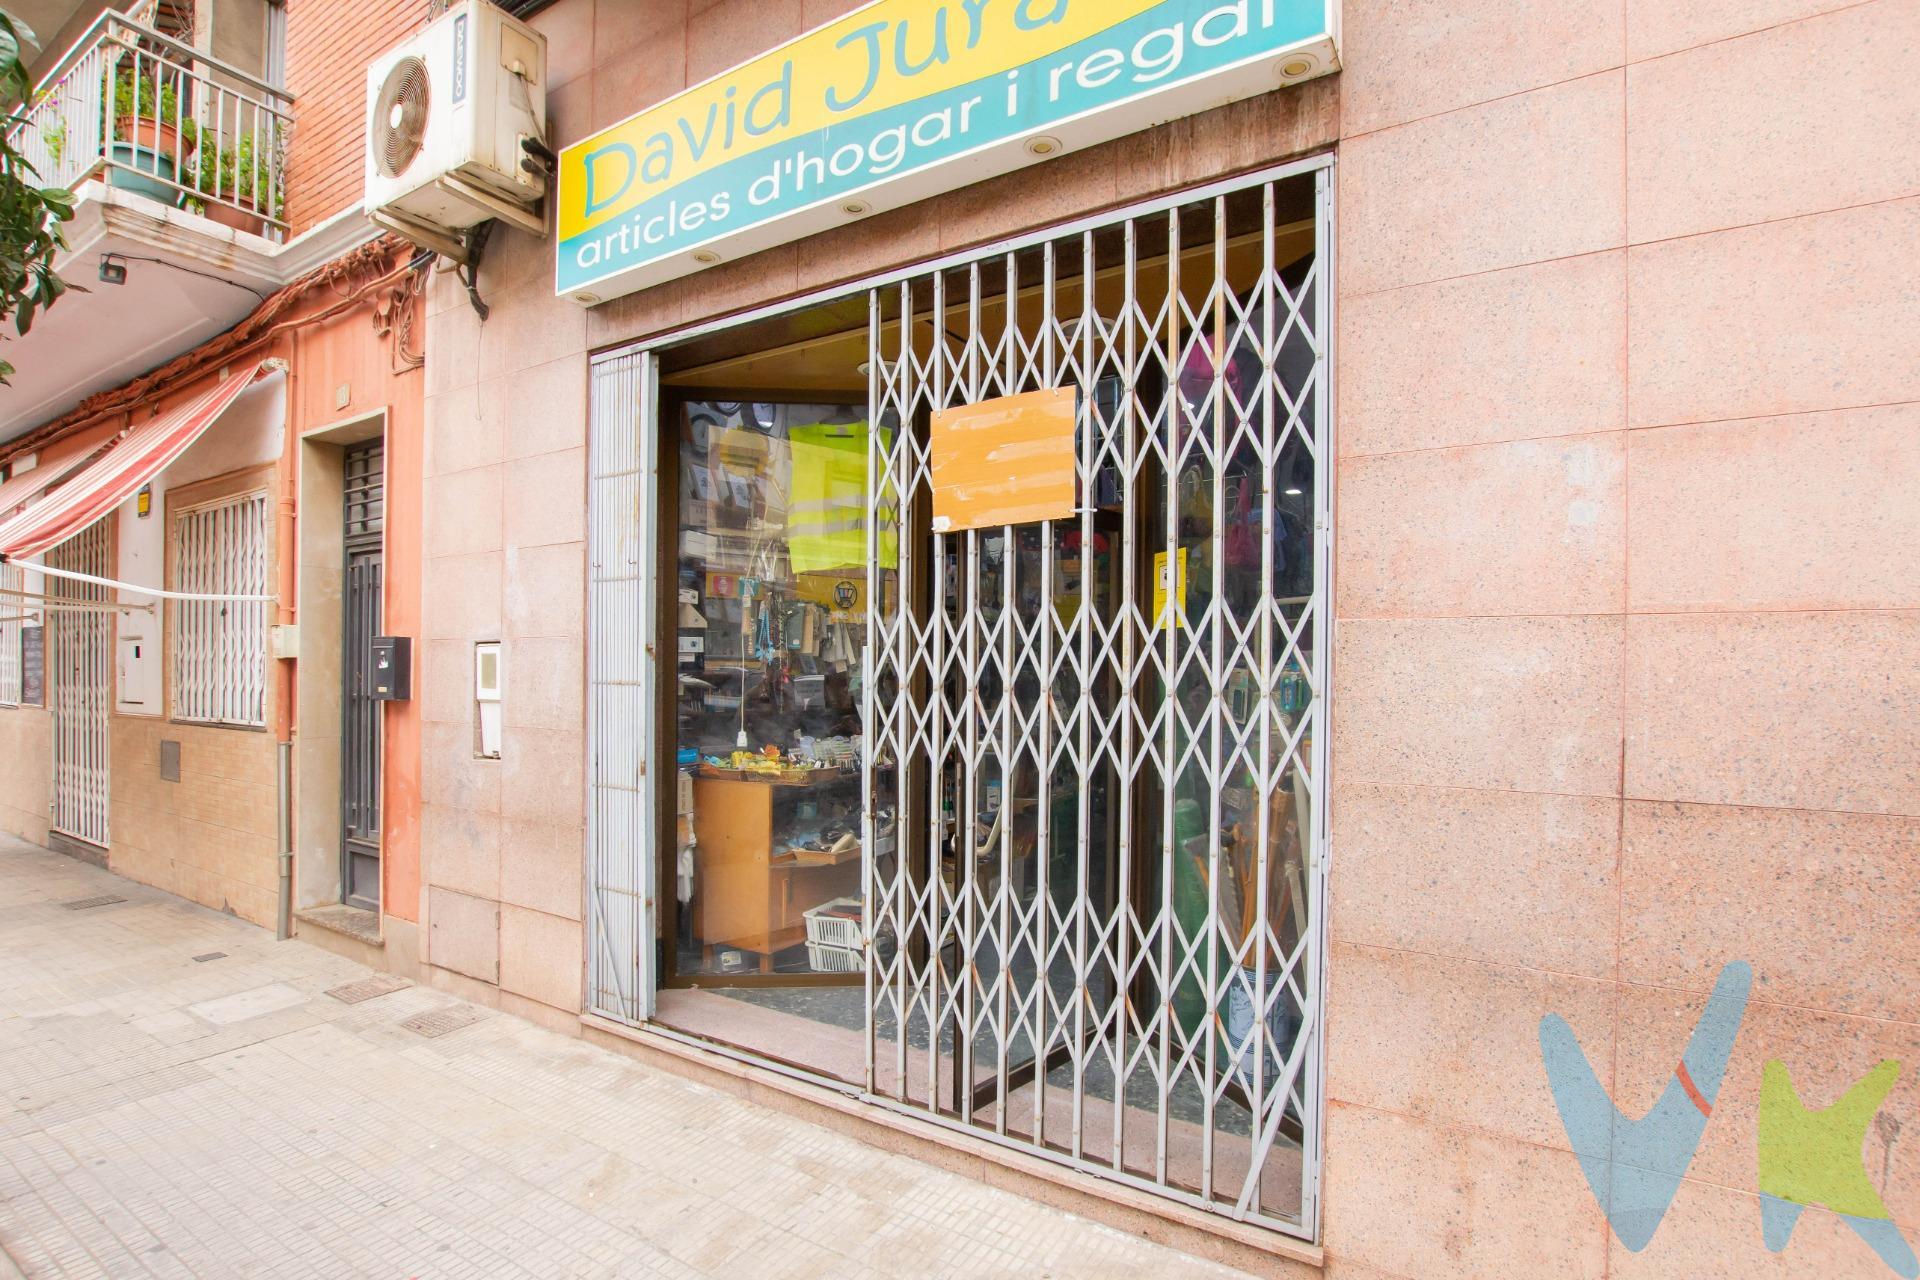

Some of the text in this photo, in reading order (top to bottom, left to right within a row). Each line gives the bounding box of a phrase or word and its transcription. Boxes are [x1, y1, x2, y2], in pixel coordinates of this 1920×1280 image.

[454, 20, 465, 97] DAEWOO
[576, 191, 730, 268] articles
[748, 95, 982, 206] d'hogar
[1007, 69, 1018, 117] i
[584, 60, 793, 218] David
